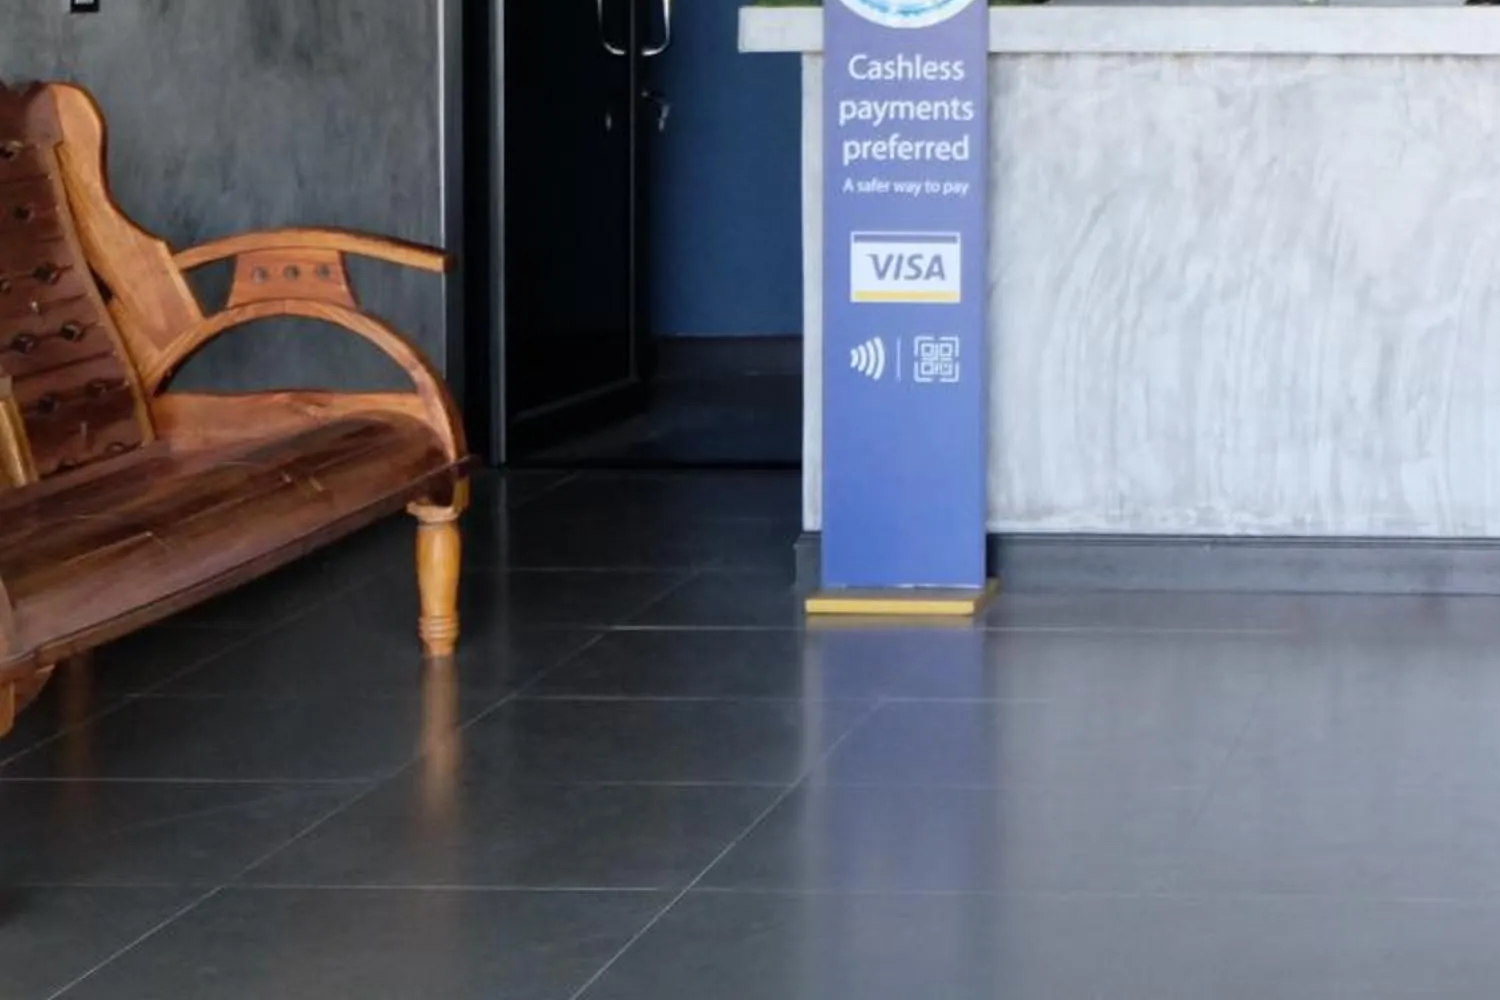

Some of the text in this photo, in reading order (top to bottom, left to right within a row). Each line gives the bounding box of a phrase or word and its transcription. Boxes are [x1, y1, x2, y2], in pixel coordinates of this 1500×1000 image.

[848, 53, 966, 82] Cashless
[839, 97, 975, 126] payments
[843, 133, 970, 166] preferred
[843, 176, 971, 198] A safer way to pay
[867, 253, 947, 281] VISA
